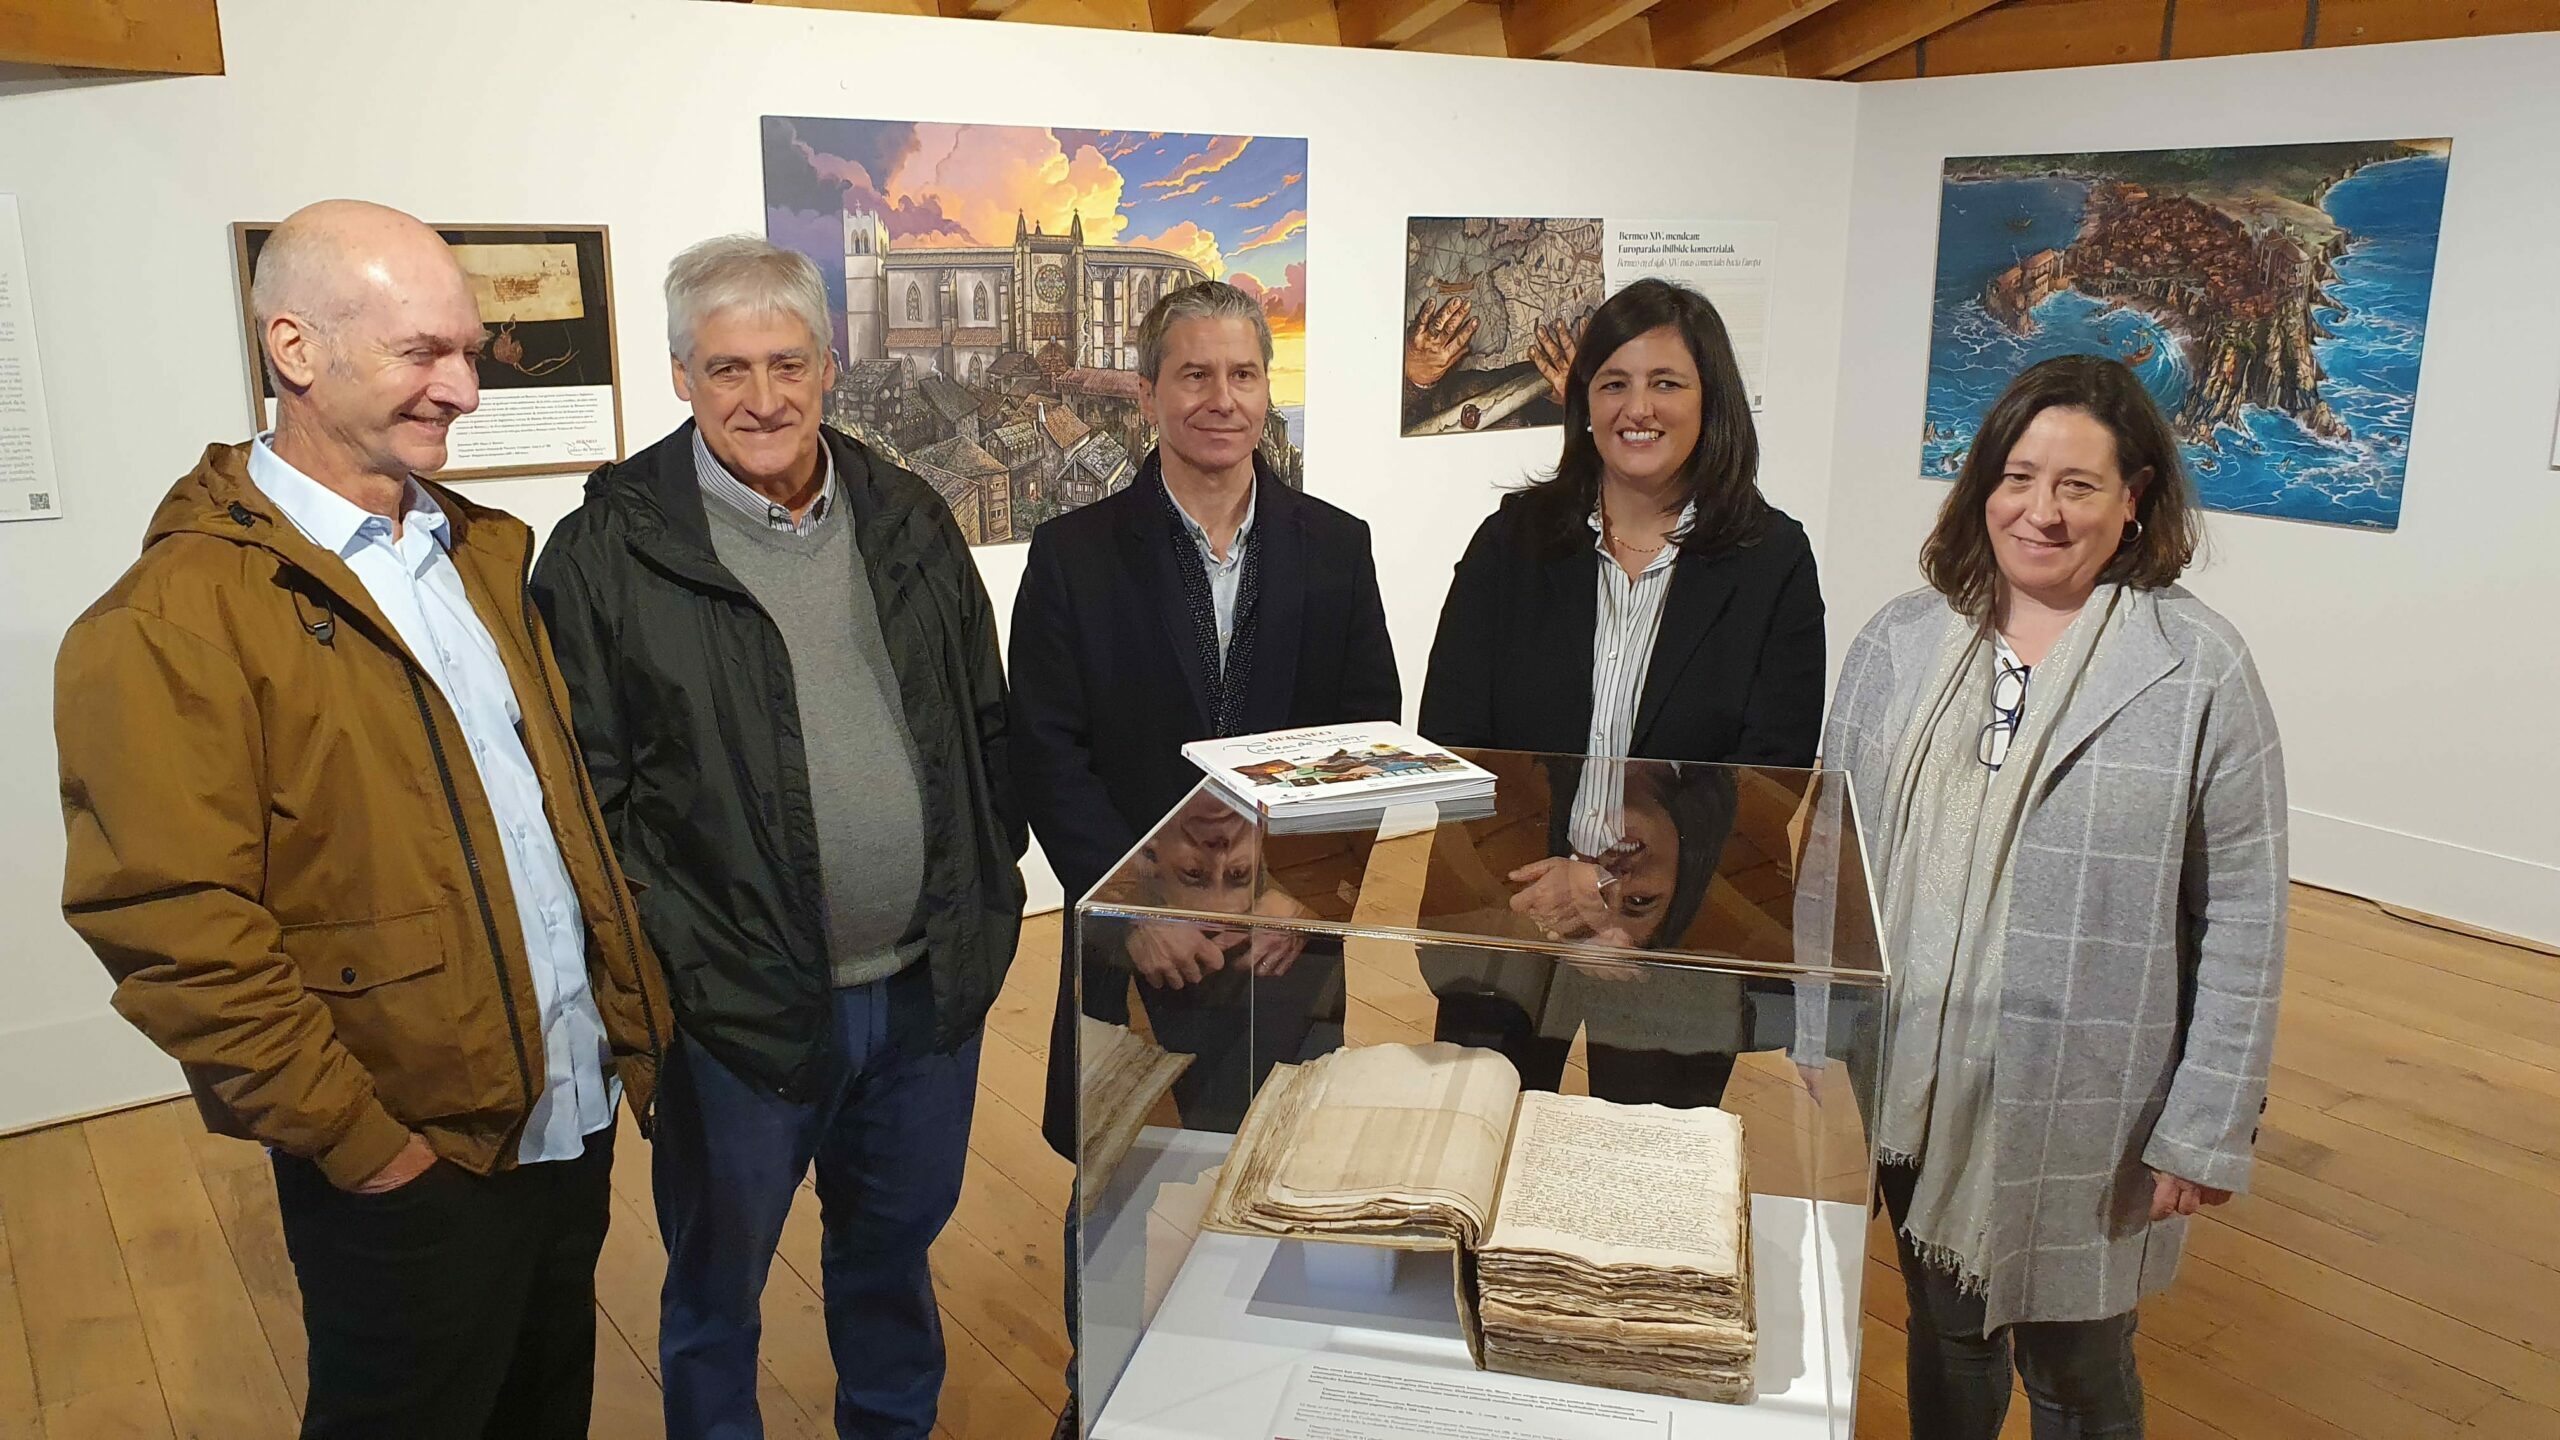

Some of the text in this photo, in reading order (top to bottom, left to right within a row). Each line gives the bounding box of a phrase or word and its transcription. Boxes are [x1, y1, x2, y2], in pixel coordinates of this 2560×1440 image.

[1619, 231, 1648, 240] Bermeo
[1618, 244, 1735, 255] Europarako ibilbide komertzialak
